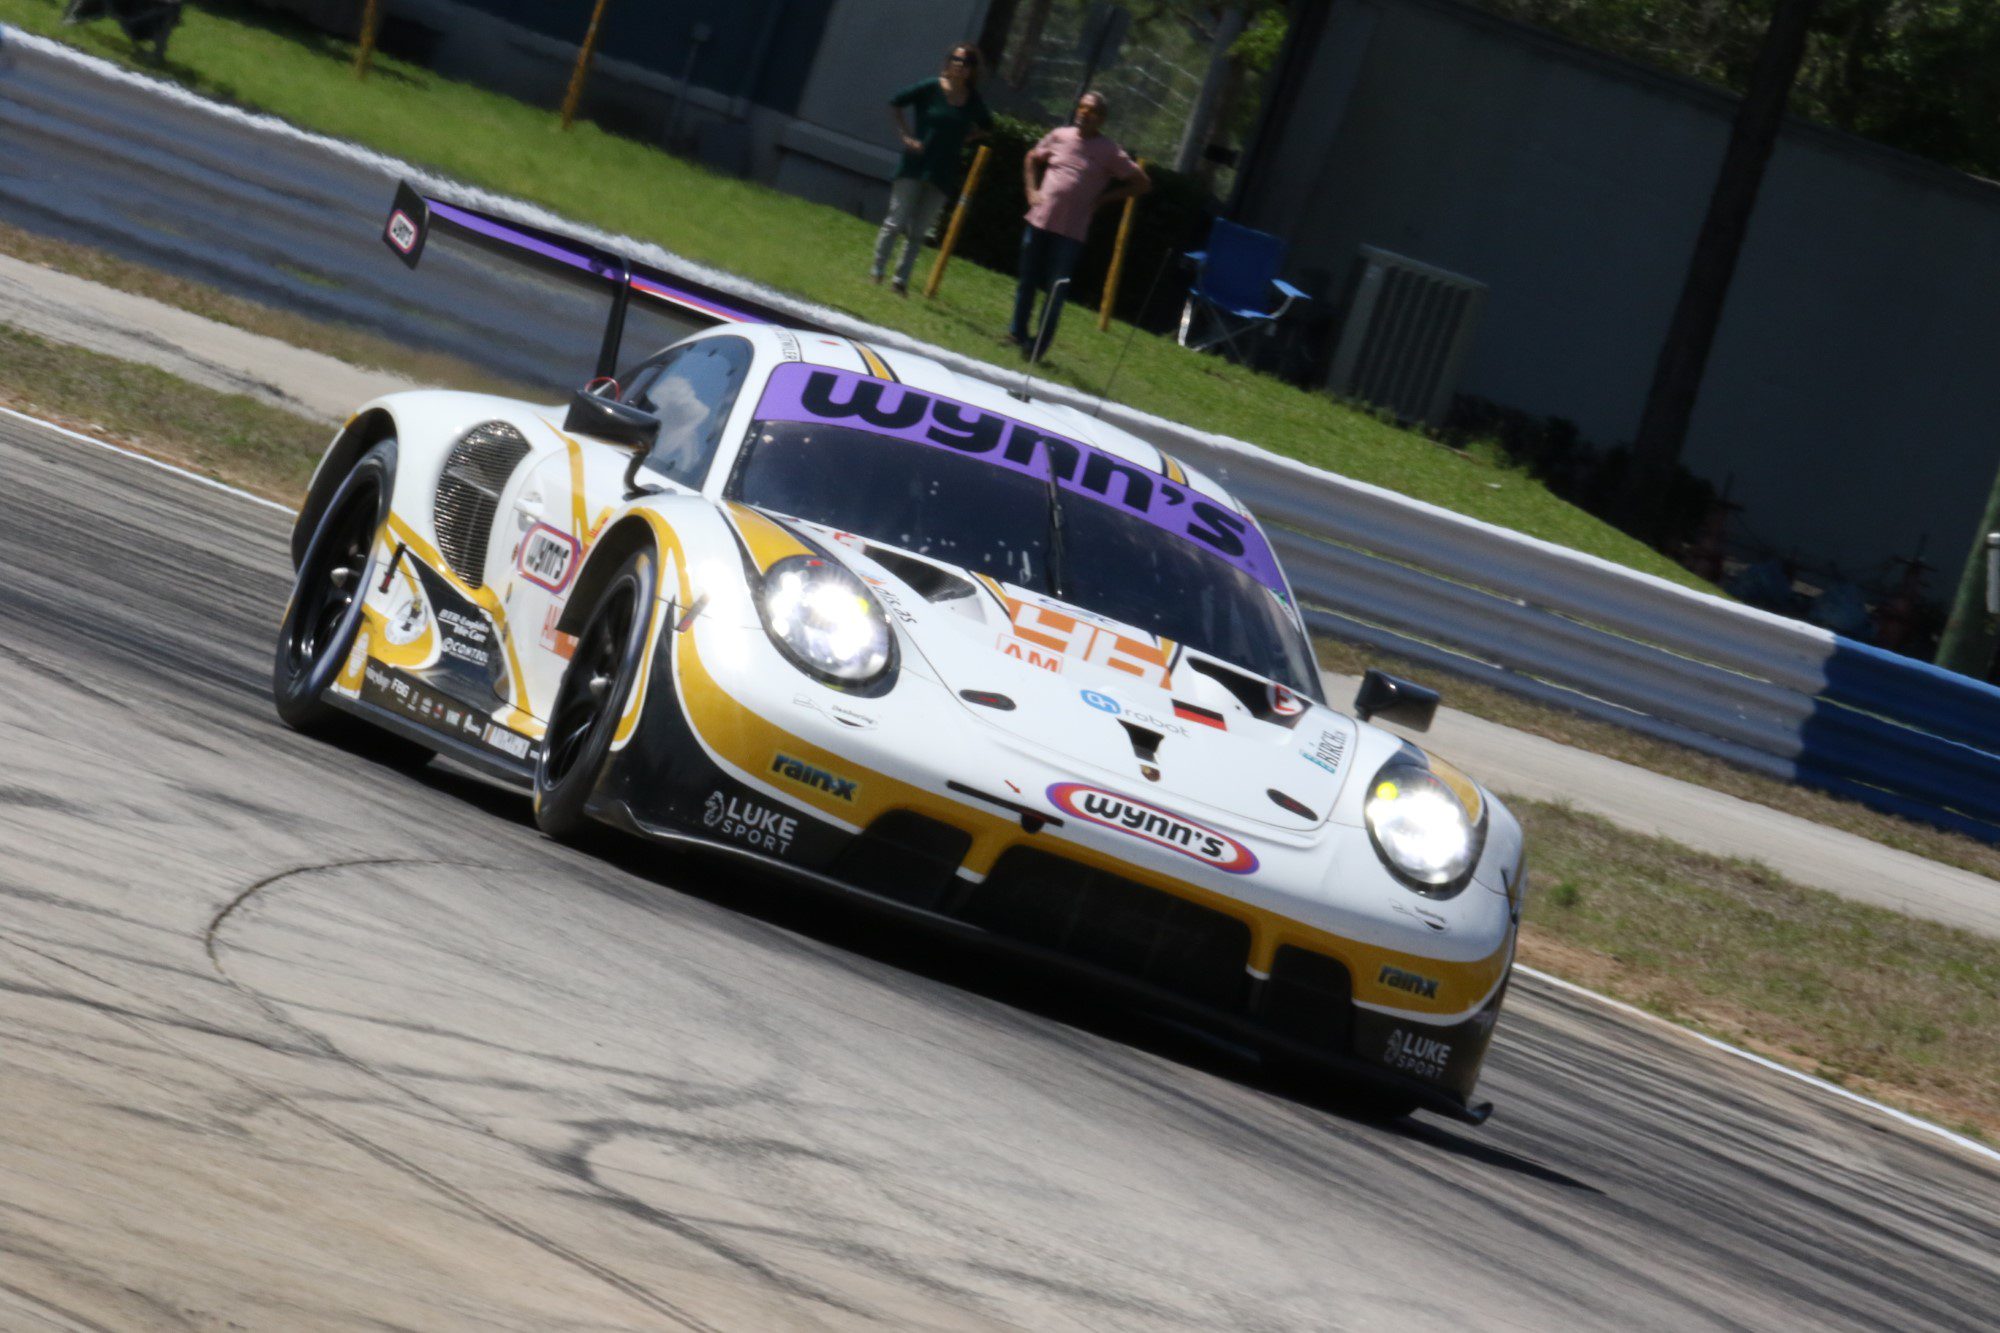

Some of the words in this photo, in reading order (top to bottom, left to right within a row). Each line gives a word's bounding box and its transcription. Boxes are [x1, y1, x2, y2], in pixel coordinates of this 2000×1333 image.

[1003, 642, 1060, 673] AM
[726, 797, 798, 840] LUKE
[721, 819, 790, 855] SPORT
[1402, 1032, 1451, 1064] LUKE
[1399, 1055, 1444, 1080] SPORT
